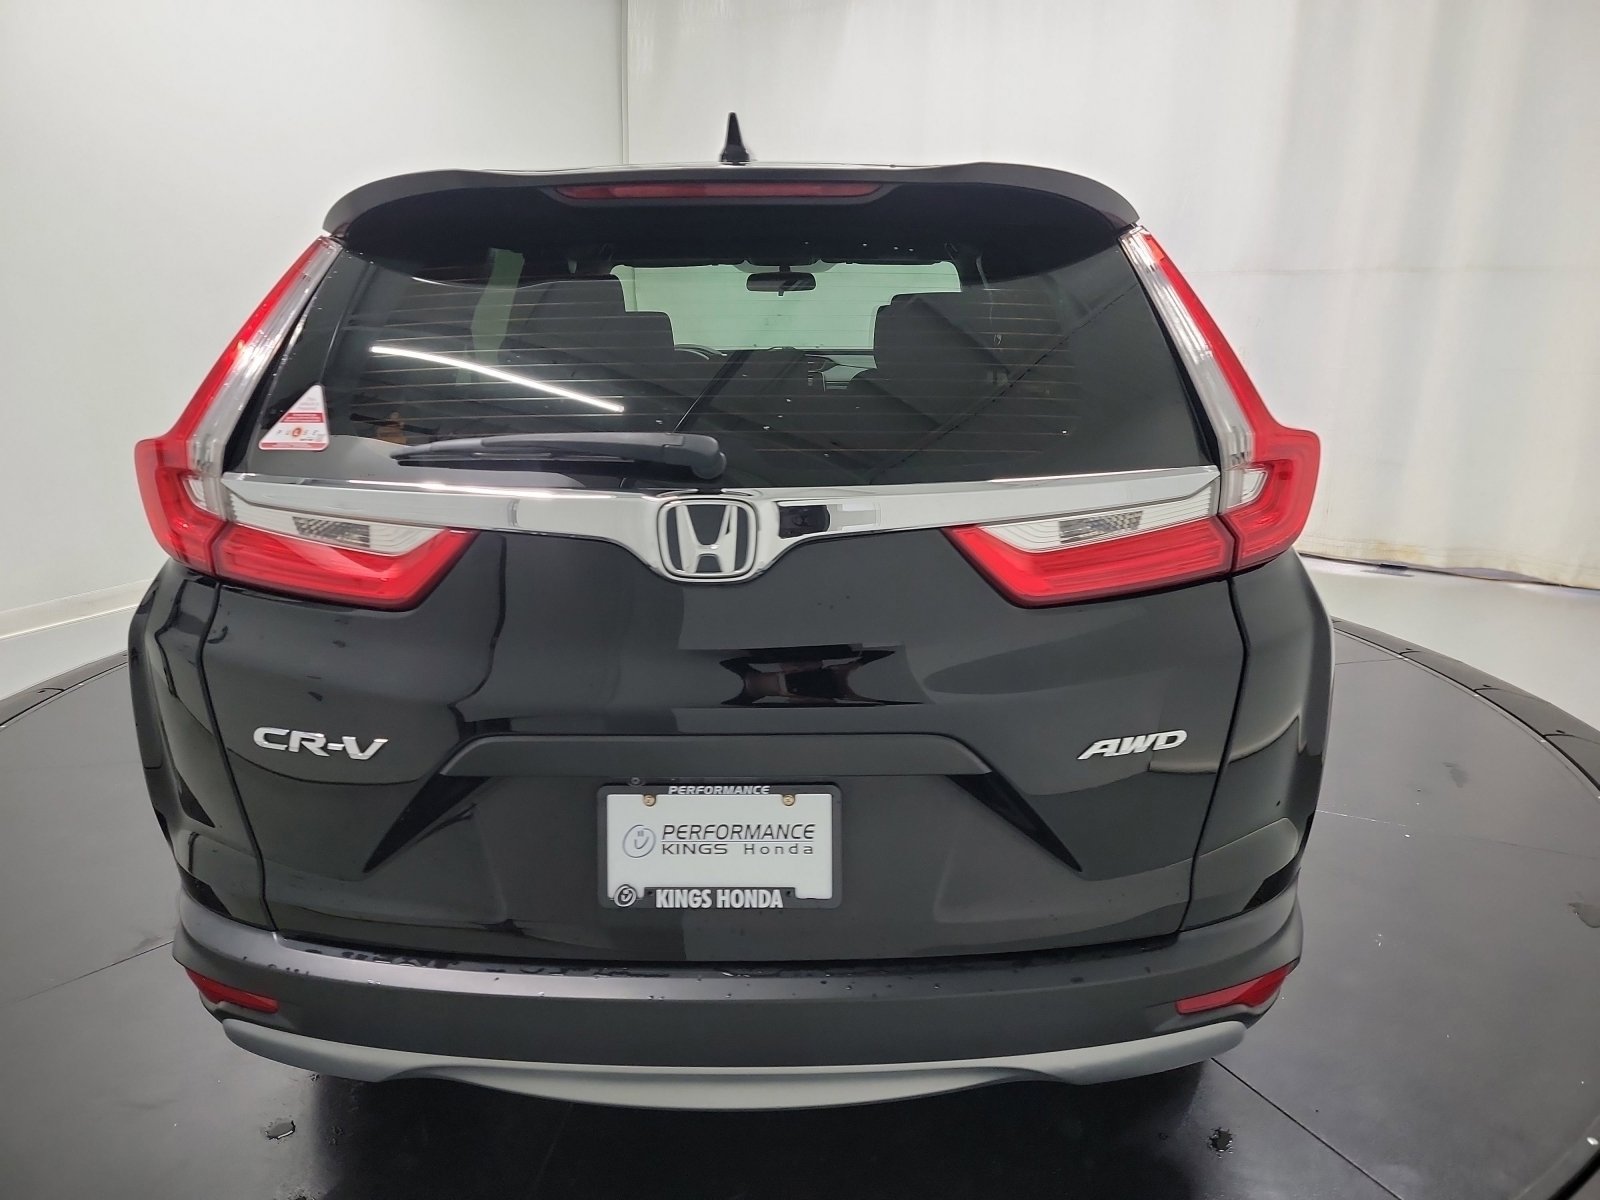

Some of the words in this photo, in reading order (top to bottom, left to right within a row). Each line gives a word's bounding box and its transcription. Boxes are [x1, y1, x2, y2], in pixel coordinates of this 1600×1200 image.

[253, 727, 389, 760] CR-V
[1077, 730, 1187, 760] AWD
[668, 785, 770, 795] PERFORMANCE
[661, 824, 816, 840] PERFORMANCE
[661, 843, 728, 855] KINGS
[744, 843, 814, 855] Honda
[655, 888, 713, 909] KINGS
[716, 888, 784, 909] HONDA
